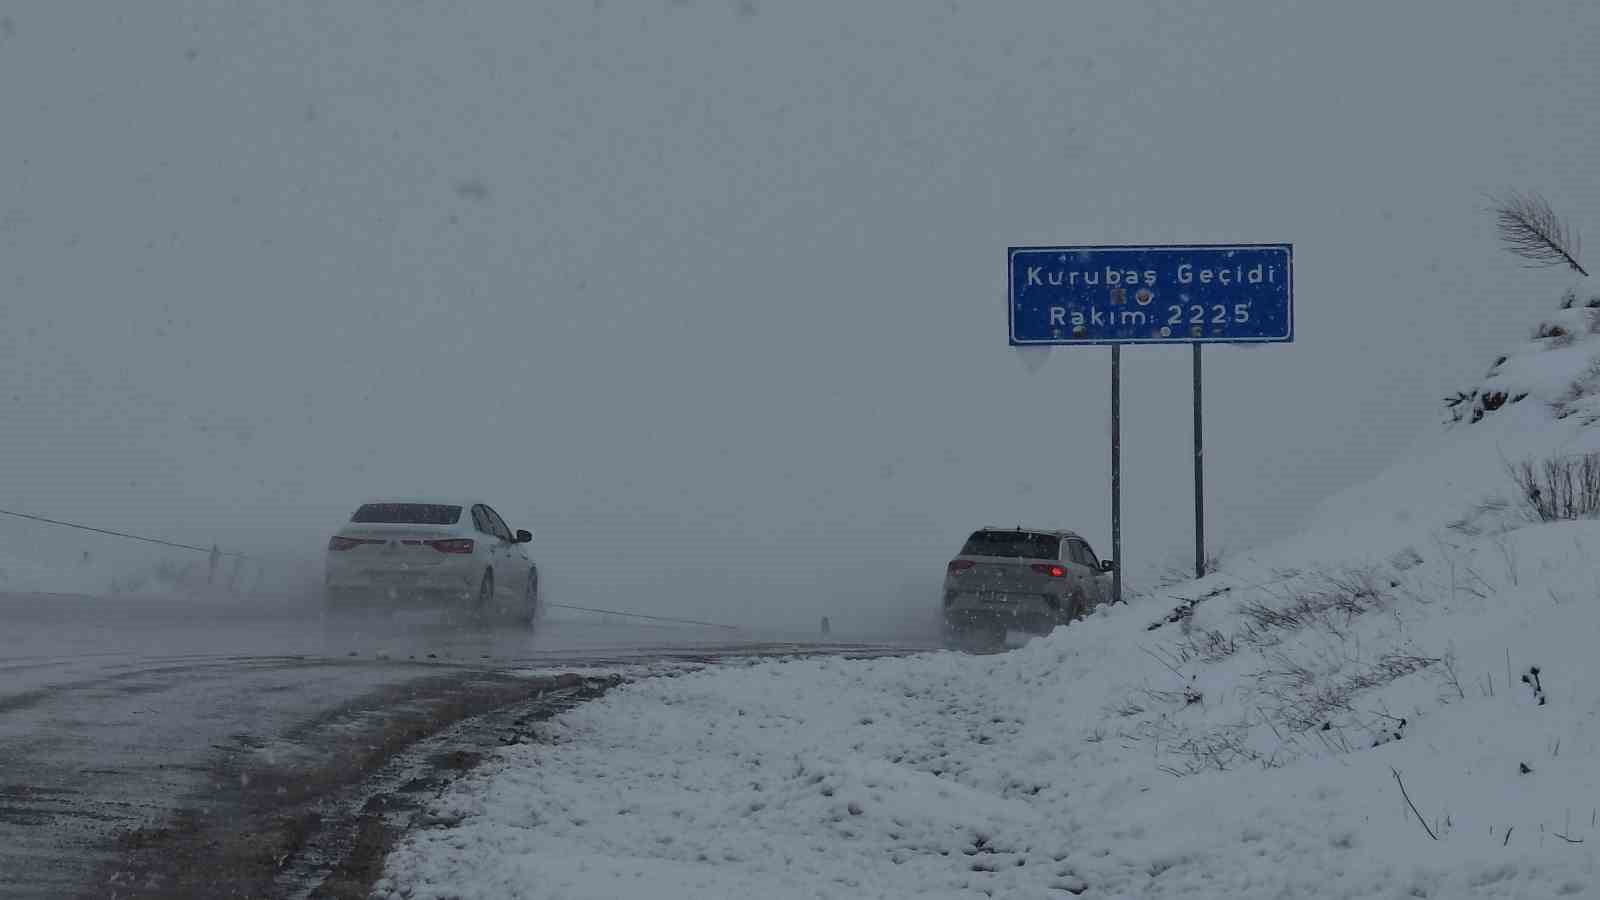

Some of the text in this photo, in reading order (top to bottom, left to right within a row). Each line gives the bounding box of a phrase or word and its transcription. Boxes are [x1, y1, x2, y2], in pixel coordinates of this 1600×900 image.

[1027, 264, 1275, 286] Kurubaş Geçidi
[1167, 304, 1250, 325] 2225
